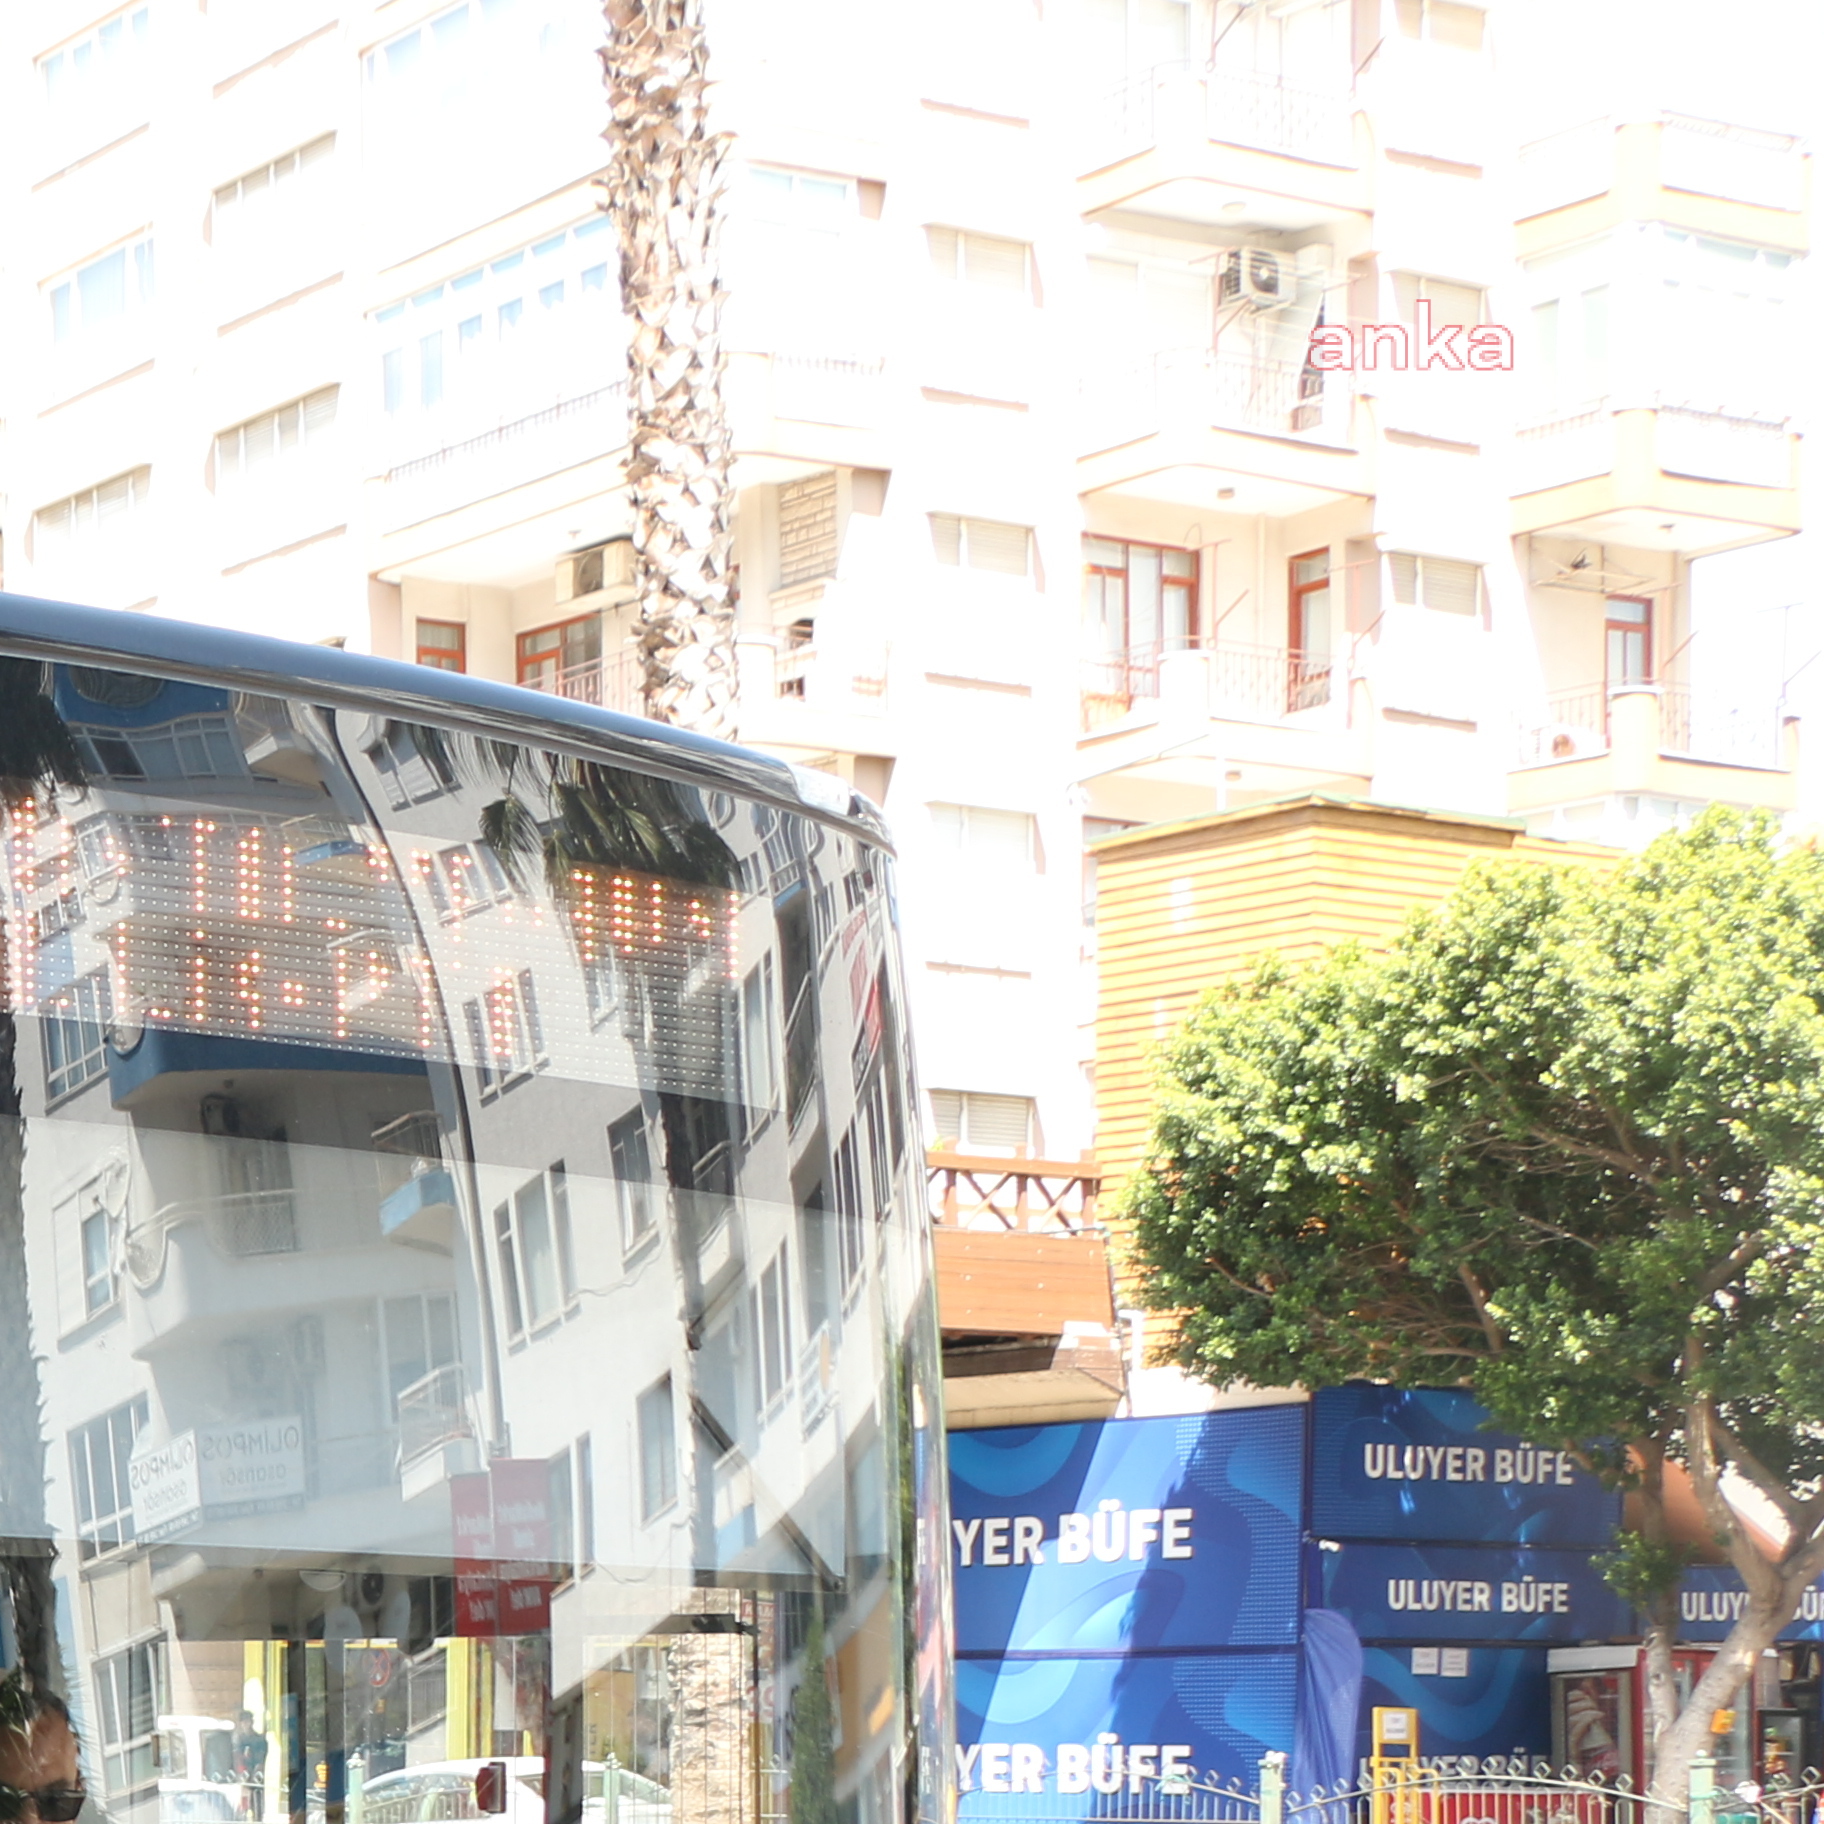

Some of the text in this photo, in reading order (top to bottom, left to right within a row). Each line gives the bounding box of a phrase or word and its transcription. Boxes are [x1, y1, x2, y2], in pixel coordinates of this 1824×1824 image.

[1364, 1438, 1574, 1486] ULUYER BÜFE
[952, 1499, 1193, 1568] YER BÜFE
[1388, 1577, 1569, 1614] ULUYER BÜFE
[1682, 1591, 1749, 1622] ULUY
[954, 1732, 1193, 1795] YER BÜFE
